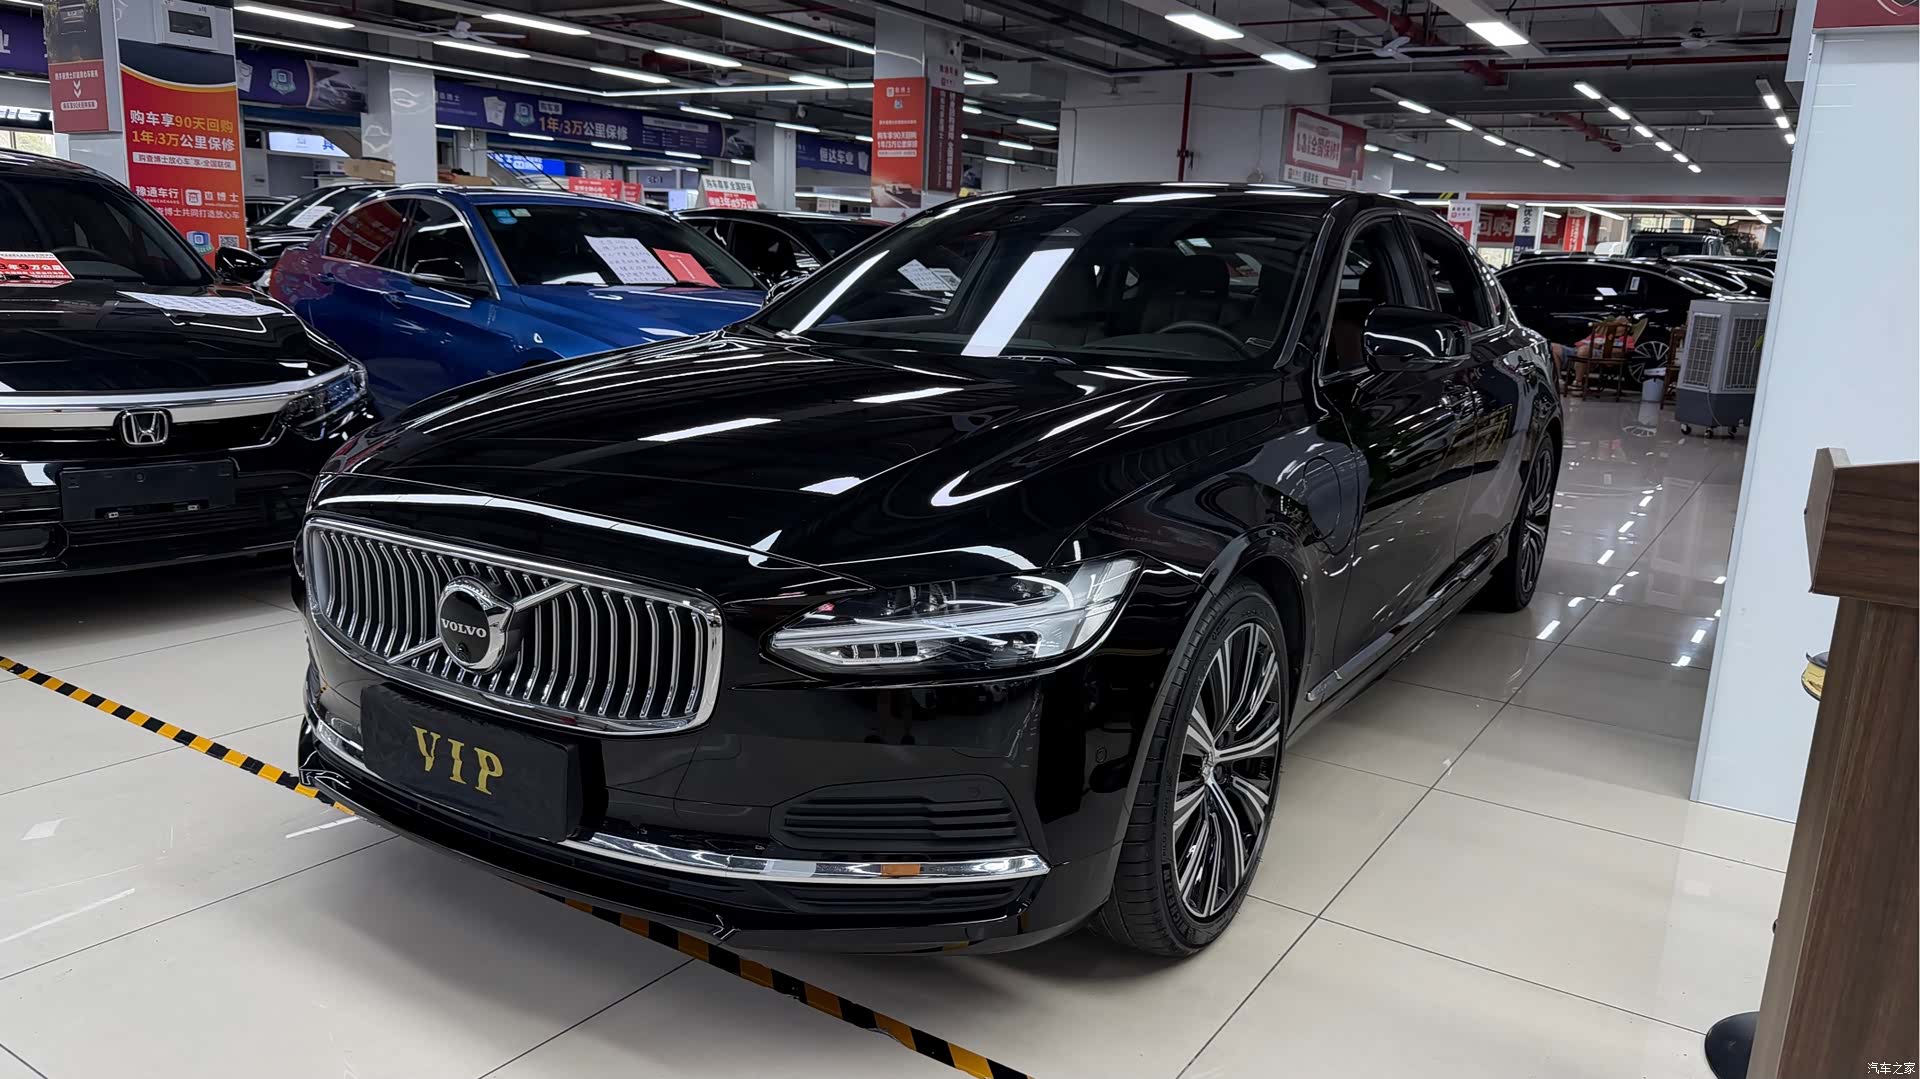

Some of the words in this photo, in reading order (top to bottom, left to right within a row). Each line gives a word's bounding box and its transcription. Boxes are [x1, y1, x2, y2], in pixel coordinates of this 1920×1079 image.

[130, 109, 233, 133] 购车享90天回购
[539, 116, 628, 141] 1年/3万公里保修
[131, 130, 236, 152] 1年/3万公里保修
[820, 147, 854, 166] 恒达车业
[441, 618, 487, 638] VOLVO
[412, 725, 504, 795] VIP
[1163, 868, 1189, 935] MICHELIN
